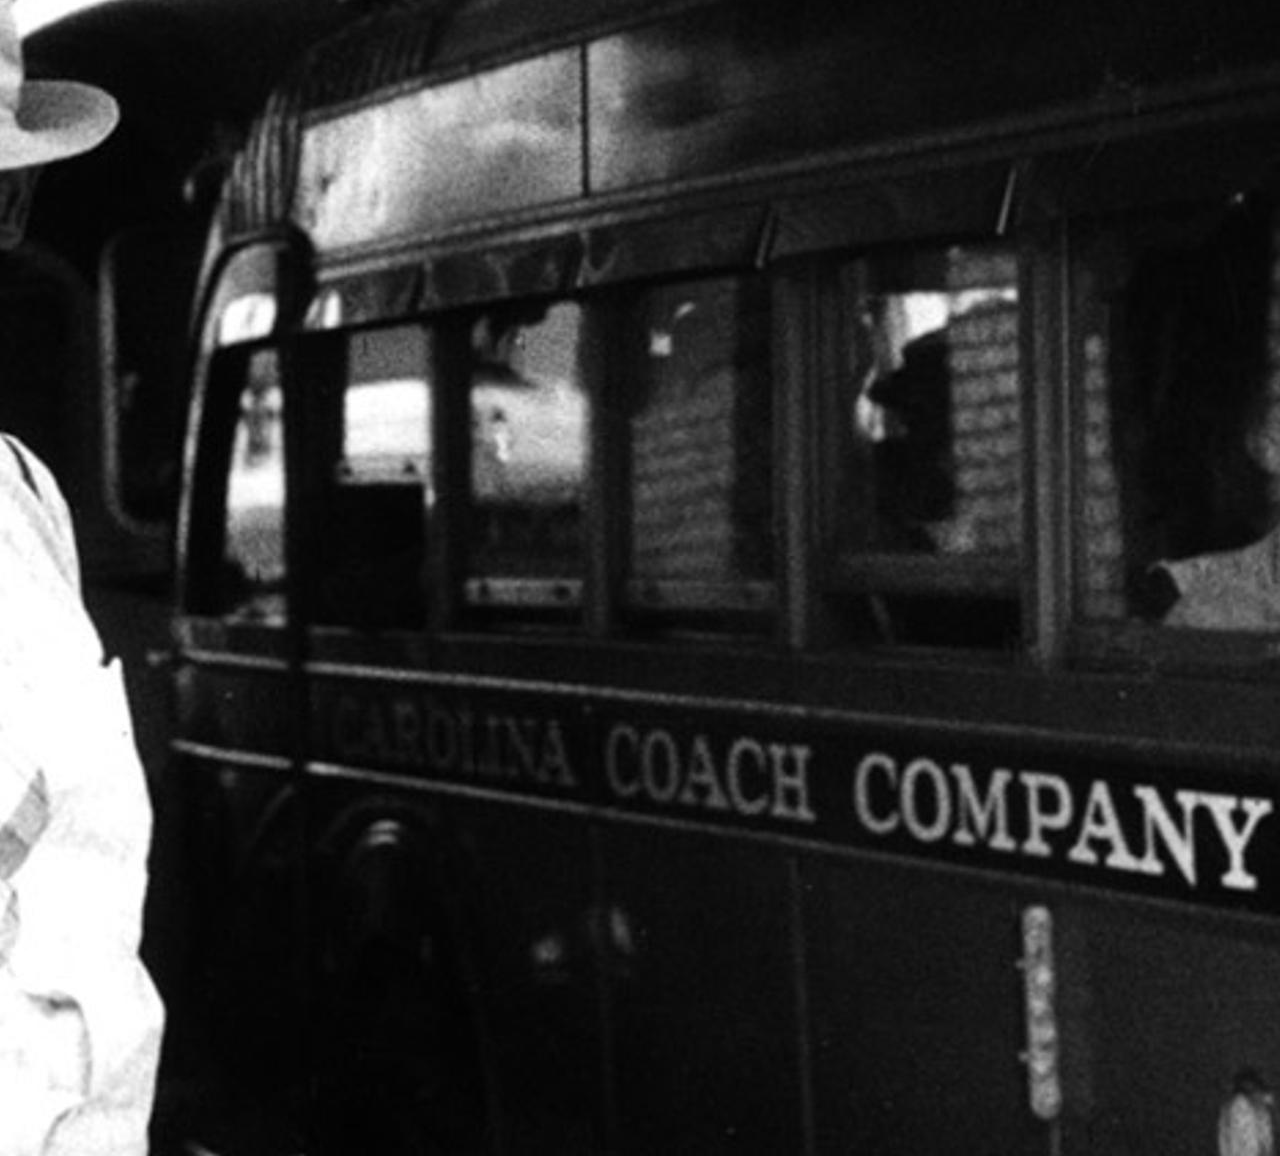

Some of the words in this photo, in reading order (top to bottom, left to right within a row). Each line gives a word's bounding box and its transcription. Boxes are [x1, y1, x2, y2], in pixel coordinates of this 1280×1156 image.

[333, 695, 577, 787] CAROLINA
[606, 723, 815, 823] COACH
[854, 751, 1272, 890] COMPANY
